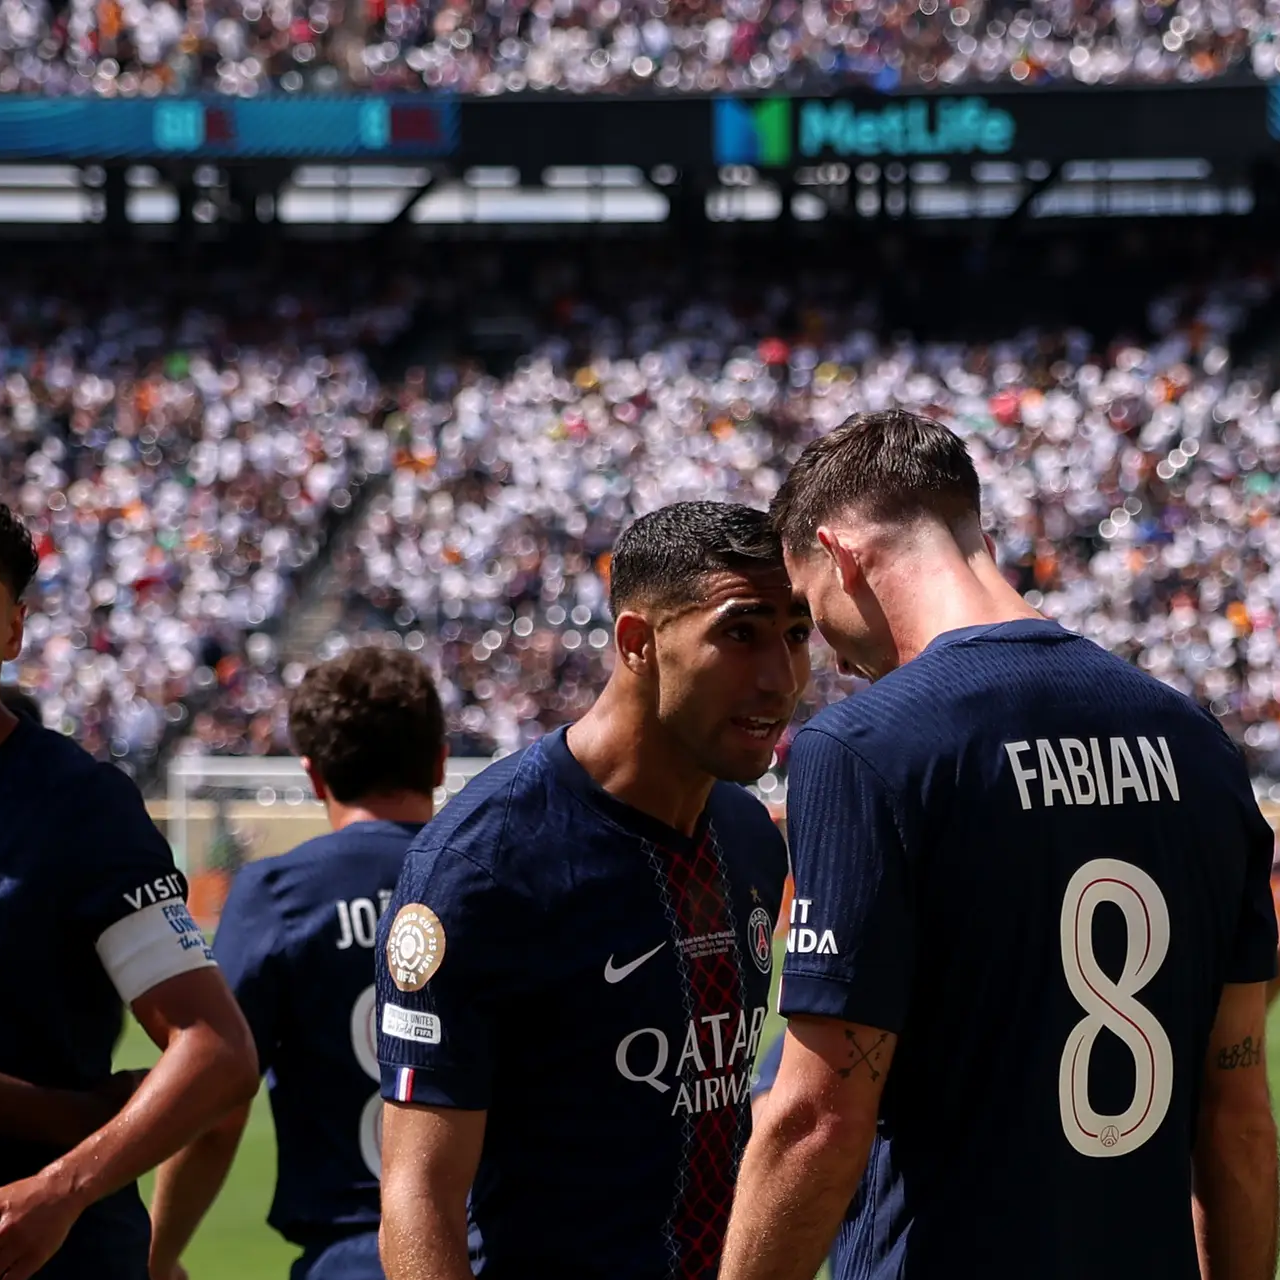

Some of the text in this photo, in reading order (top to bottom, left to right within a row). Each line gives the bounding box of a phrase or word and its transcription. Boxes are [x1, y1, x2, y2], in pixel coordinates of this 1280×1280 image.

[800, 97, 1014, 155] MetLife
[1004, 736, 1180, 809] FABIAN
[123, 874, 182, 909] VISIT
[418, 916, 436, 935] CUP
[1059, 858, 1173, 1157] 8
[616, 1006, 766, 1093] QATAR
